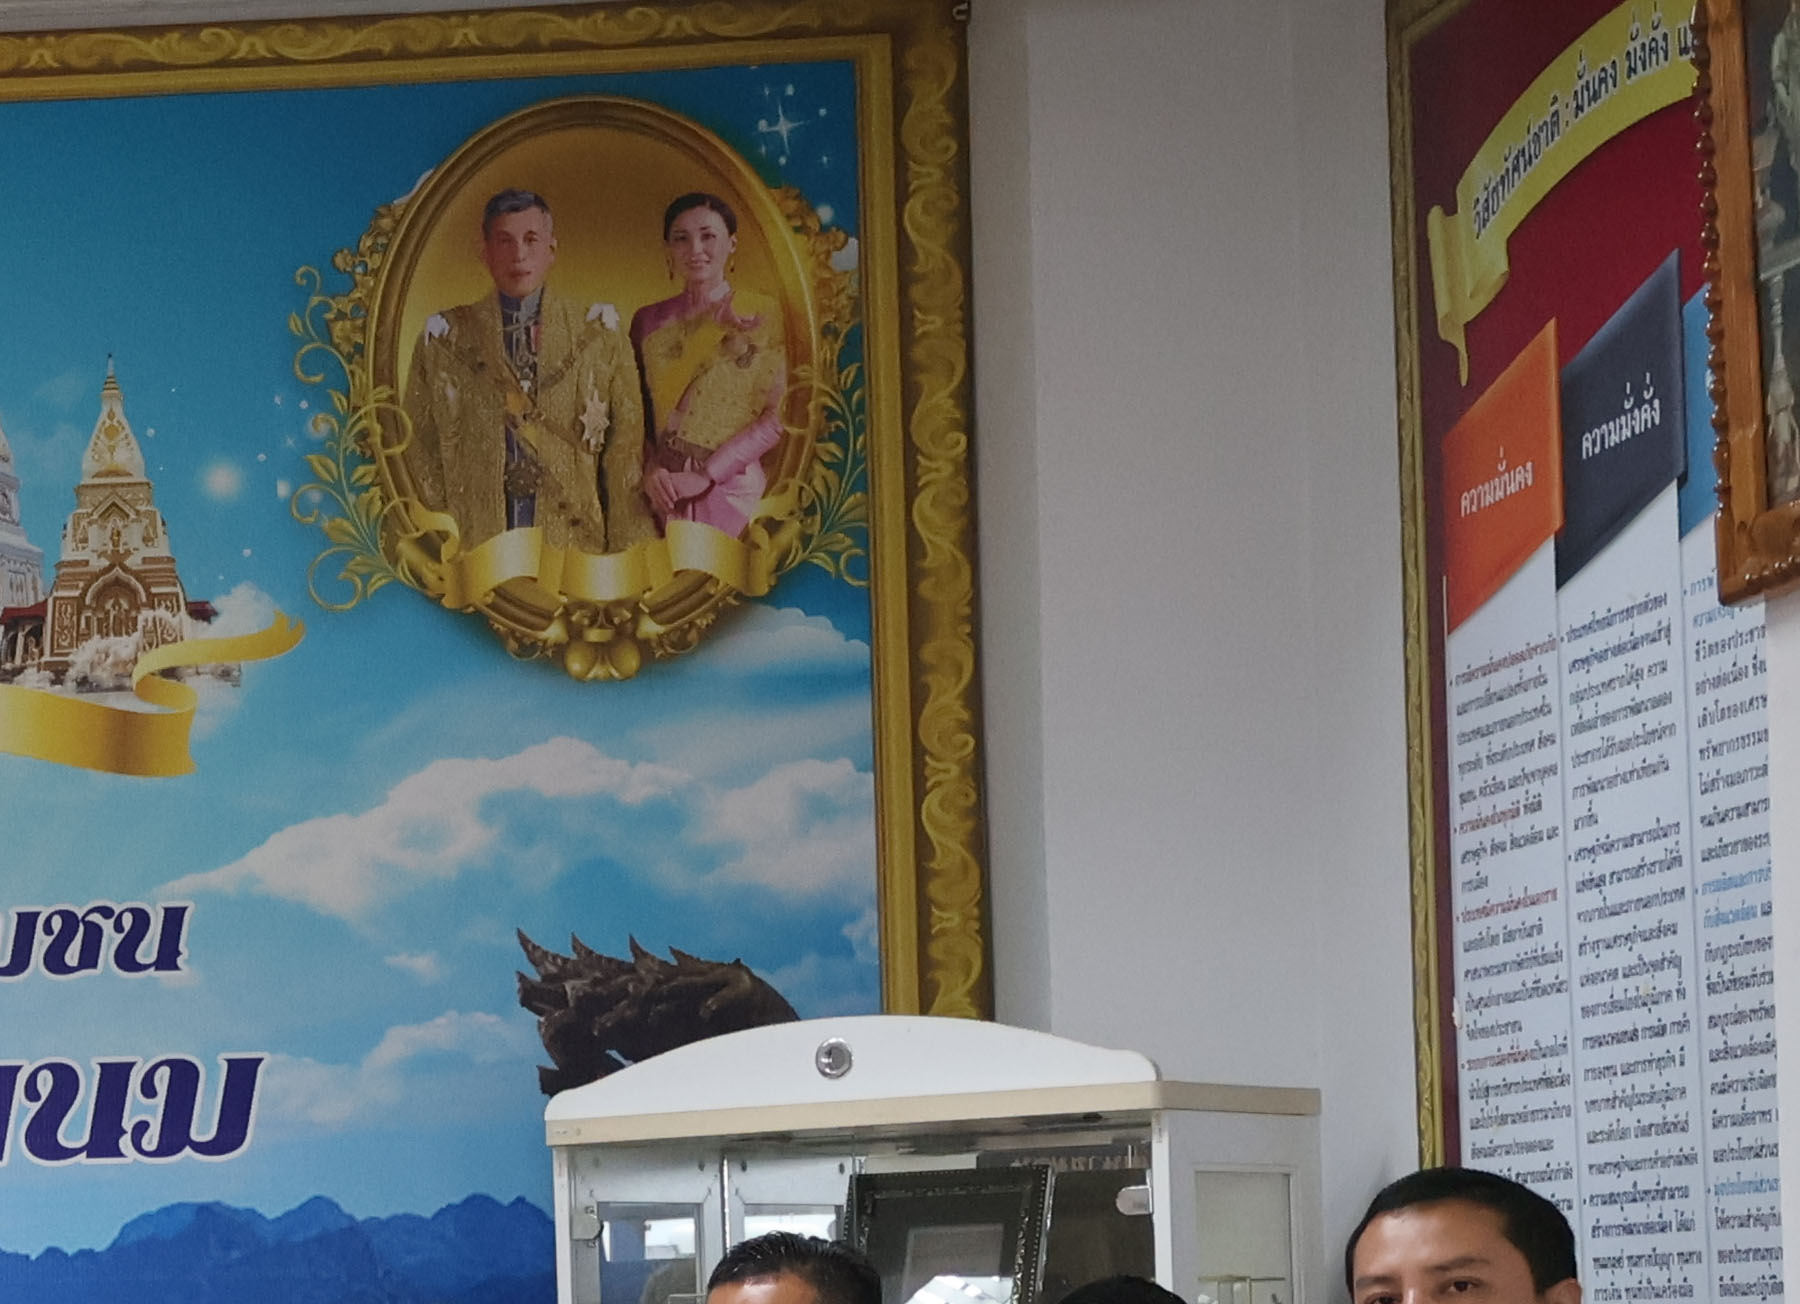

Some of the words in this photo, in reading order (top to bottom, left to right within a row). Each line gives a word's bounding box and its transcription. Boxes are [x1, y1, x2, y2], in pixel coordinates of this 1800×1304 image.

[1573, 49, 1618, 120] มั่นคง
[1580, 373, 1662, 460] ความมั่งคั่ง
[1460, 448, 1534, 518] ความมั่นคง
